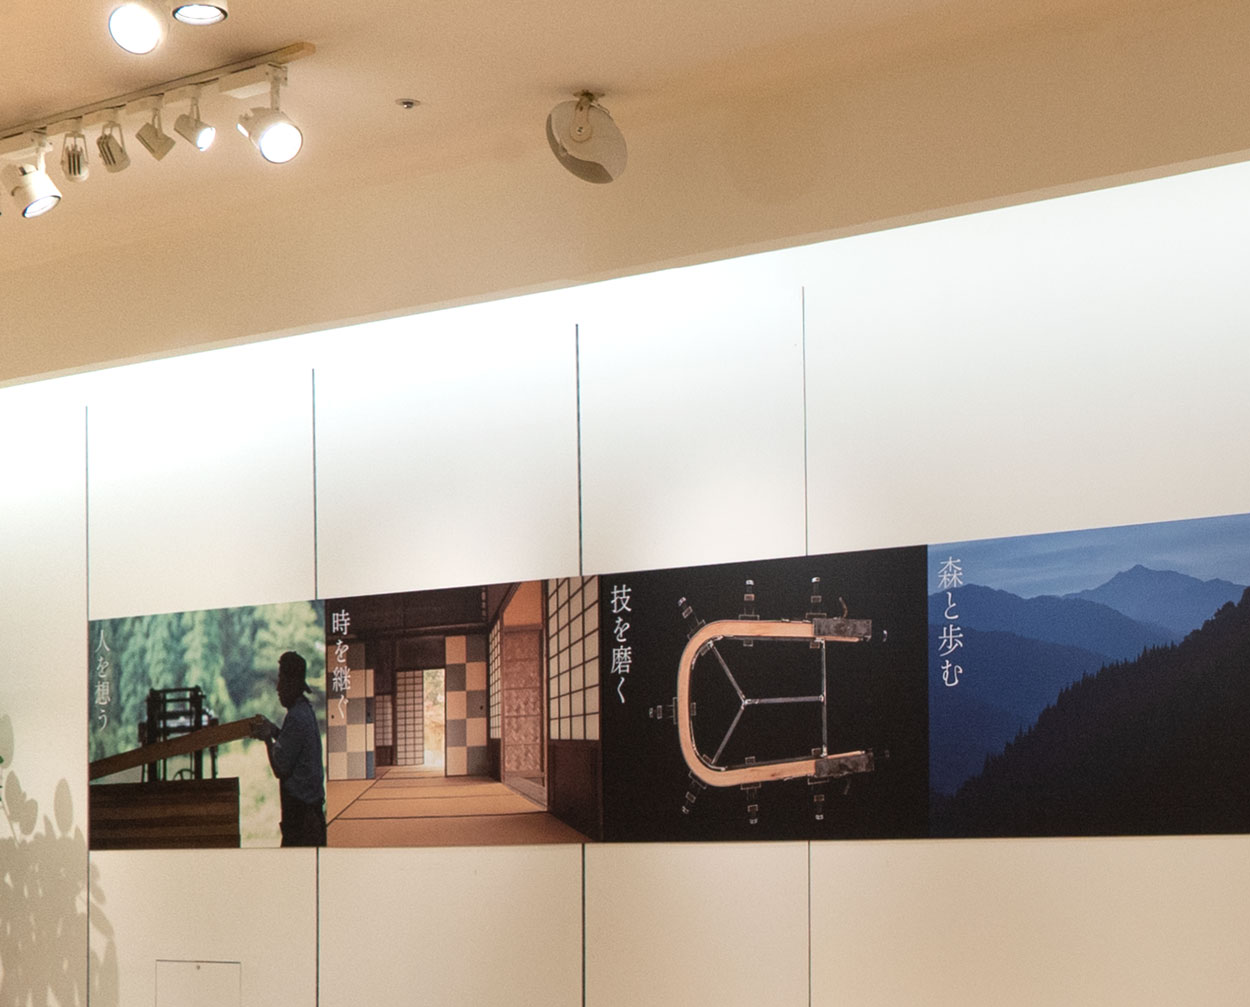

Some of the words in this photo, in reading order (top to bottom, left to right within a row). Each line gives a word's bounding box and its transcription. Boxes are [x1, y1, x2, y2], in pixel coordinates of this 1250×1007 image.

[332, 609, 351, 719] 時を継ぐ
[610, 584, 632, 704] 技を磨く
[938, 556, 963, 687] 森と歩む
[95, 629, 111, 731] 人を想う
